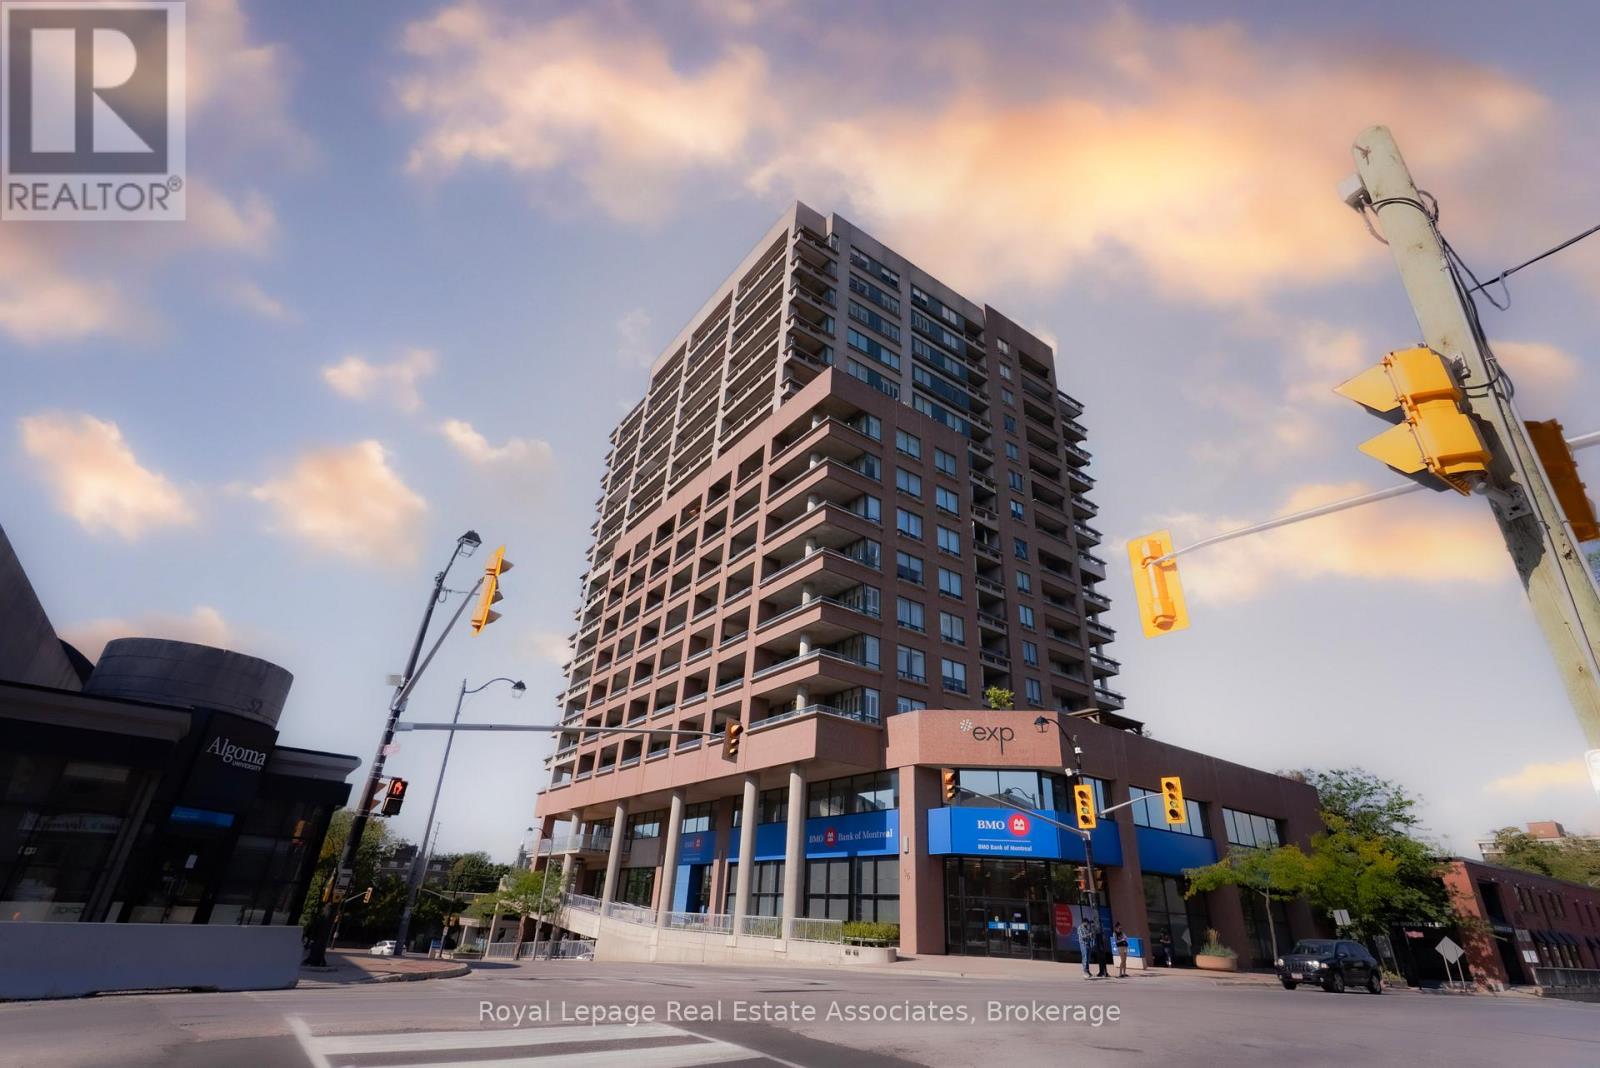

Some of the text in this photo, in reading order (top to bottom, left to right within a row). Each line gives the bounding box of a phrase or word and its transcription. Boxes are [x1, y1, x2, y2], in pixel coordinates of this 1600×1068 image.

[972, 726, 1015, 755] exp
[206, 736, 267, 766] Algoma
[231, 760, 262, 771] UNIVERSITY
[977, 819, 1006, 830] BMO
[809, 828, 893, 844] BMO Bank of Montreal
